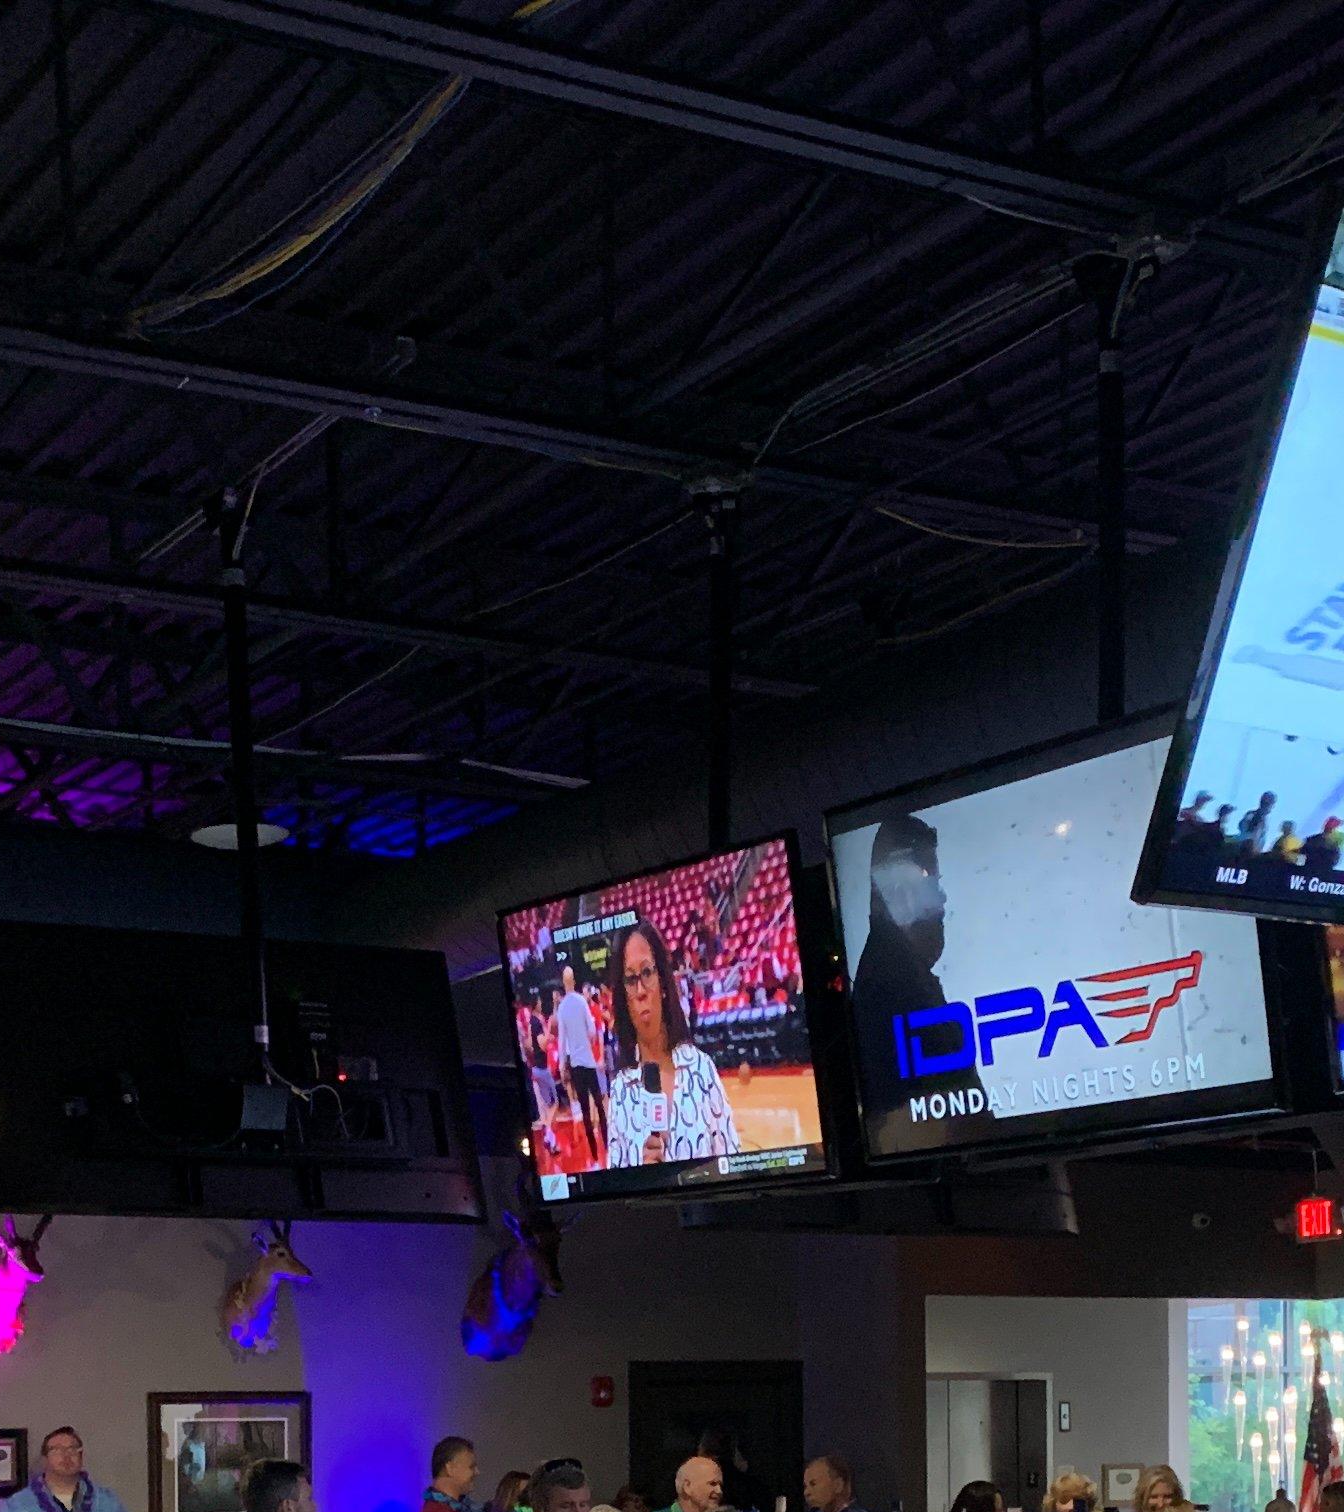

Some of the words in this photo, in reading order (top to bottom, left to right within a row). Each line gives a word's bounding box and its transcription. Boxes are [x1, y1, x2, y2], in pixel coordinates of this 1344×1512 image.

[1215, 865, 1248, 886] MLB
[1289, 874, 1307, 892] W:
[909, 1081, 1019, 1124] MONDAY
[1031, 1063, 1137, 1106] NIGHTS
[1150, 1052, 1208, 1088] 6PM
[1300, 1200, 1332, 1237] EXIT
